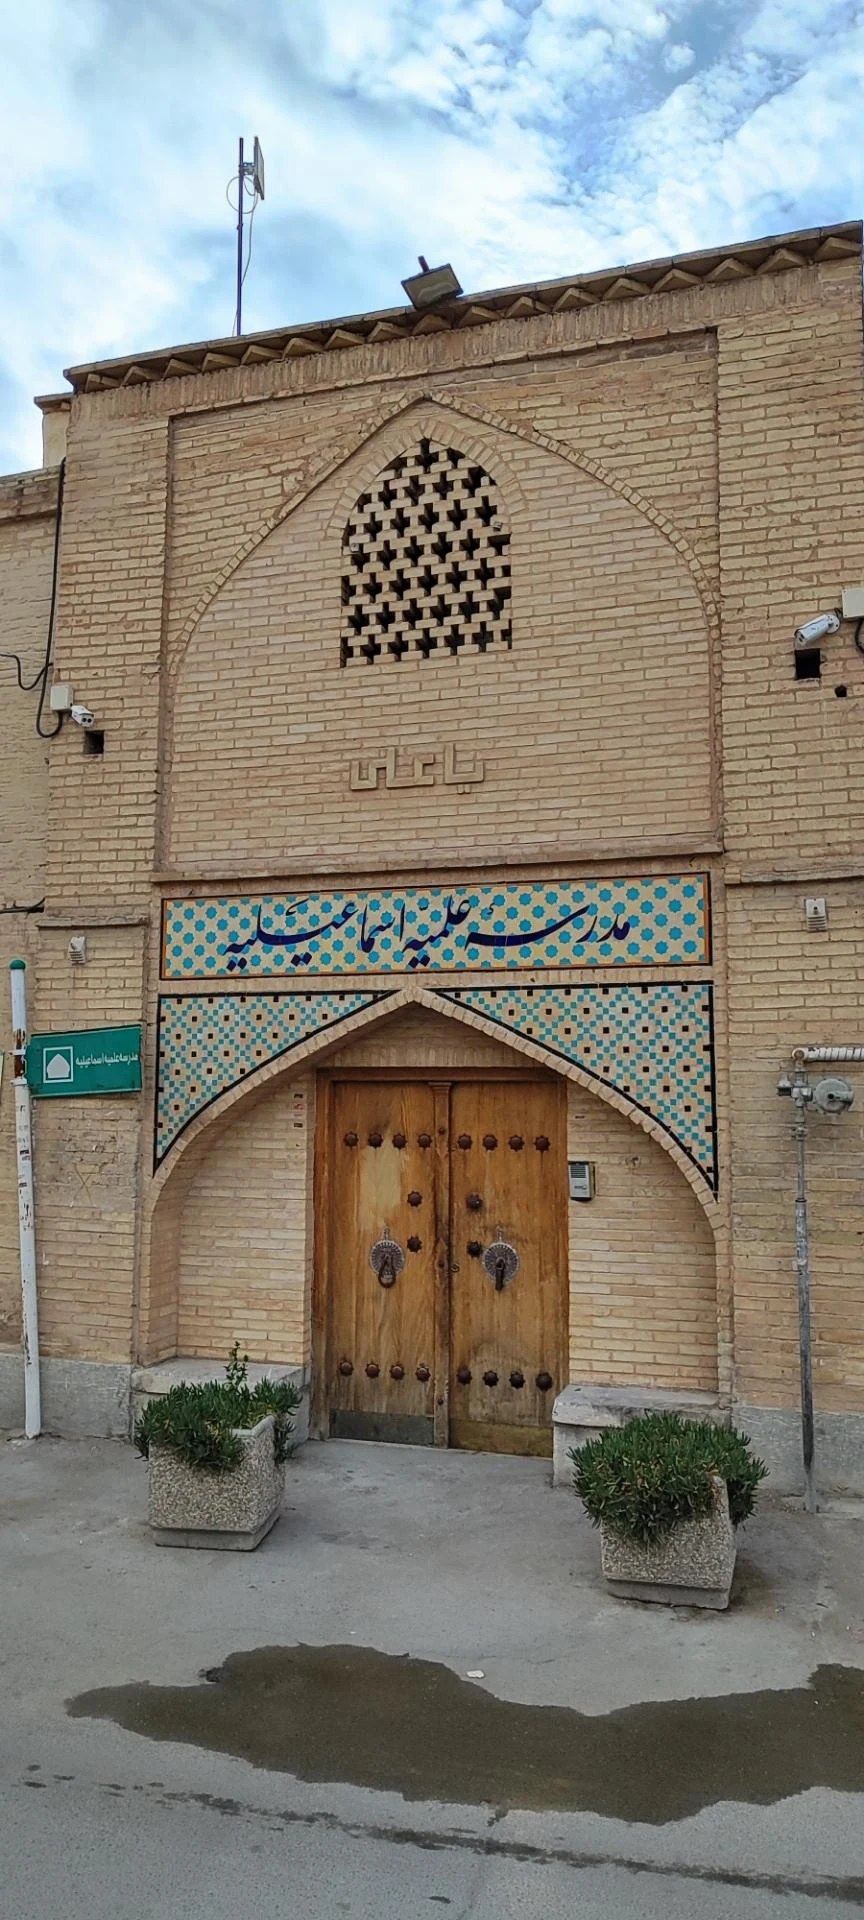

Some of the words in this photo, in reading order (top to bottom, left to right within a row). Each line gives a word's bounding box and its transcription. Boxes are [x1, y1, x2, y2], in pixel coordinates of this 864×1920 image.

[350, 747, 434, 790] علی
[444, 743, 485, 794] یا
[223, 898, 406, 972] اسماعیلیه
[75, 1051, 105, 1069] اسماعیلیه
[119, 1051, 139, 1065] مدرسه
